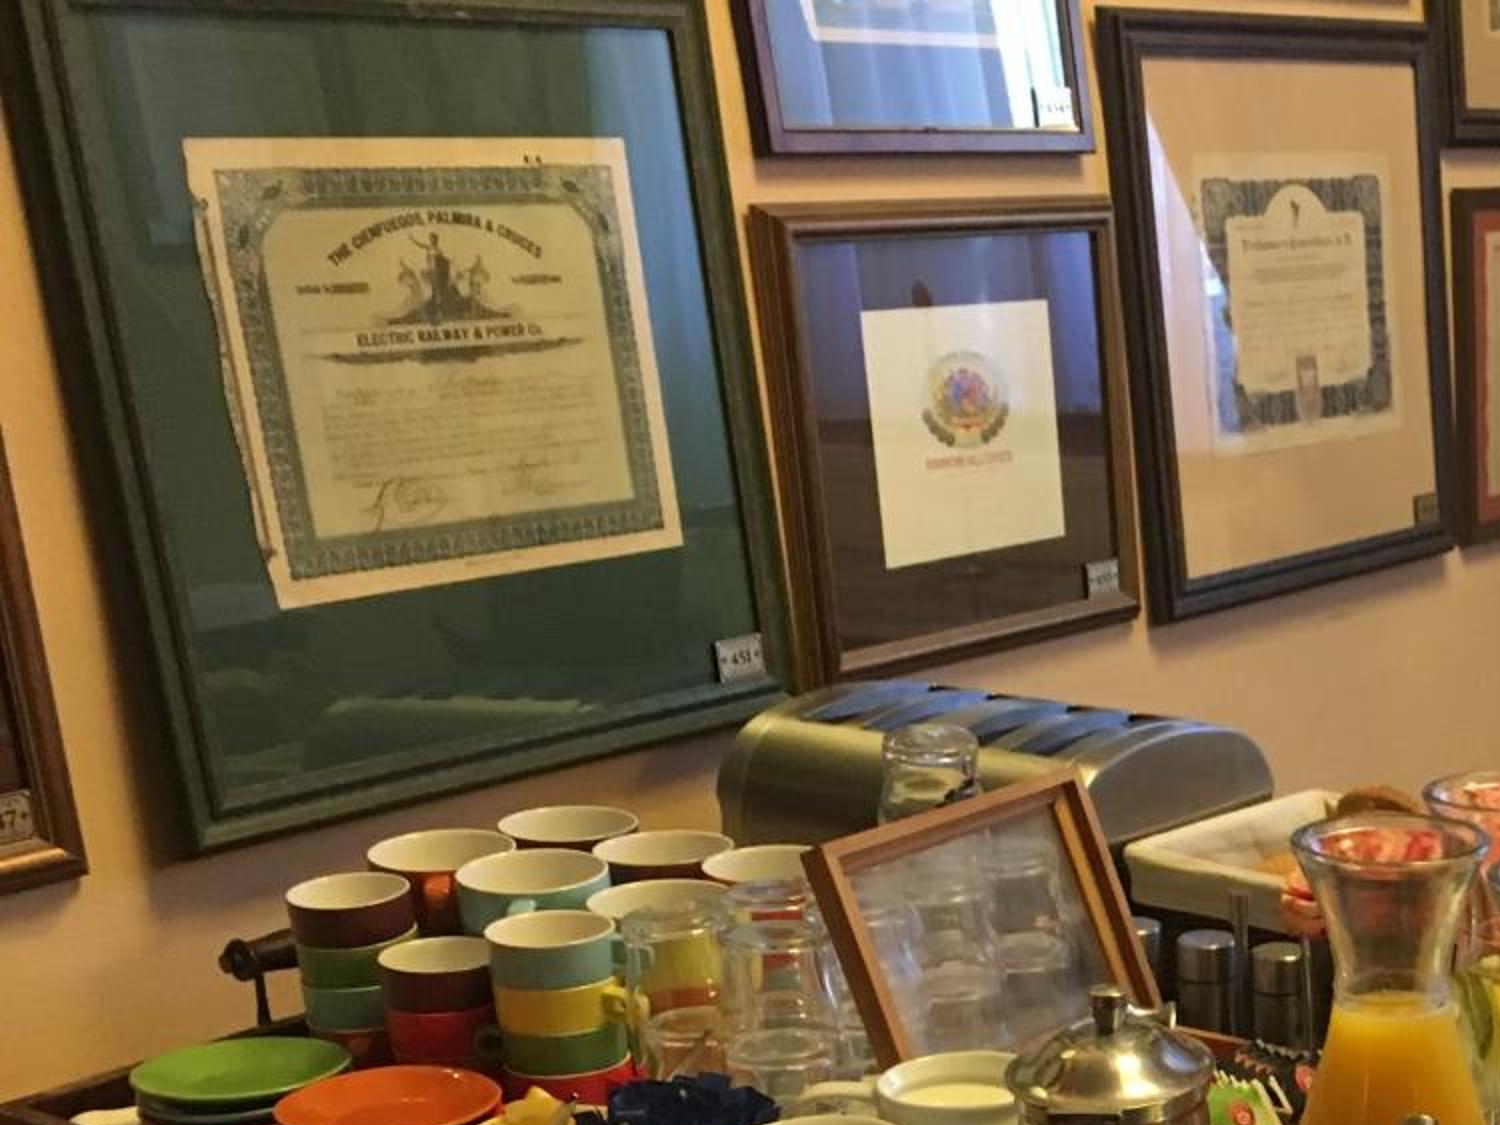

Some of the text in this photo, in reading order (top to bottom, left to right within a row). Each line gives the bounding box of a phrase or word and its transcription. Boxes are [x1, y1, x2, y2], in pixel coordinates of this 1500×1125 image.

[327, 241, 353, 268] THE
[427, 210, 482, 231] PALMIRA
[485, 217, 496, 234] &
[356, 330, 416, 348] ELECTRIC
[416, 327, 469, 342] RAILWAY
[472, 325, 484, 341] &
[486, 322, 526, 338] POWER
